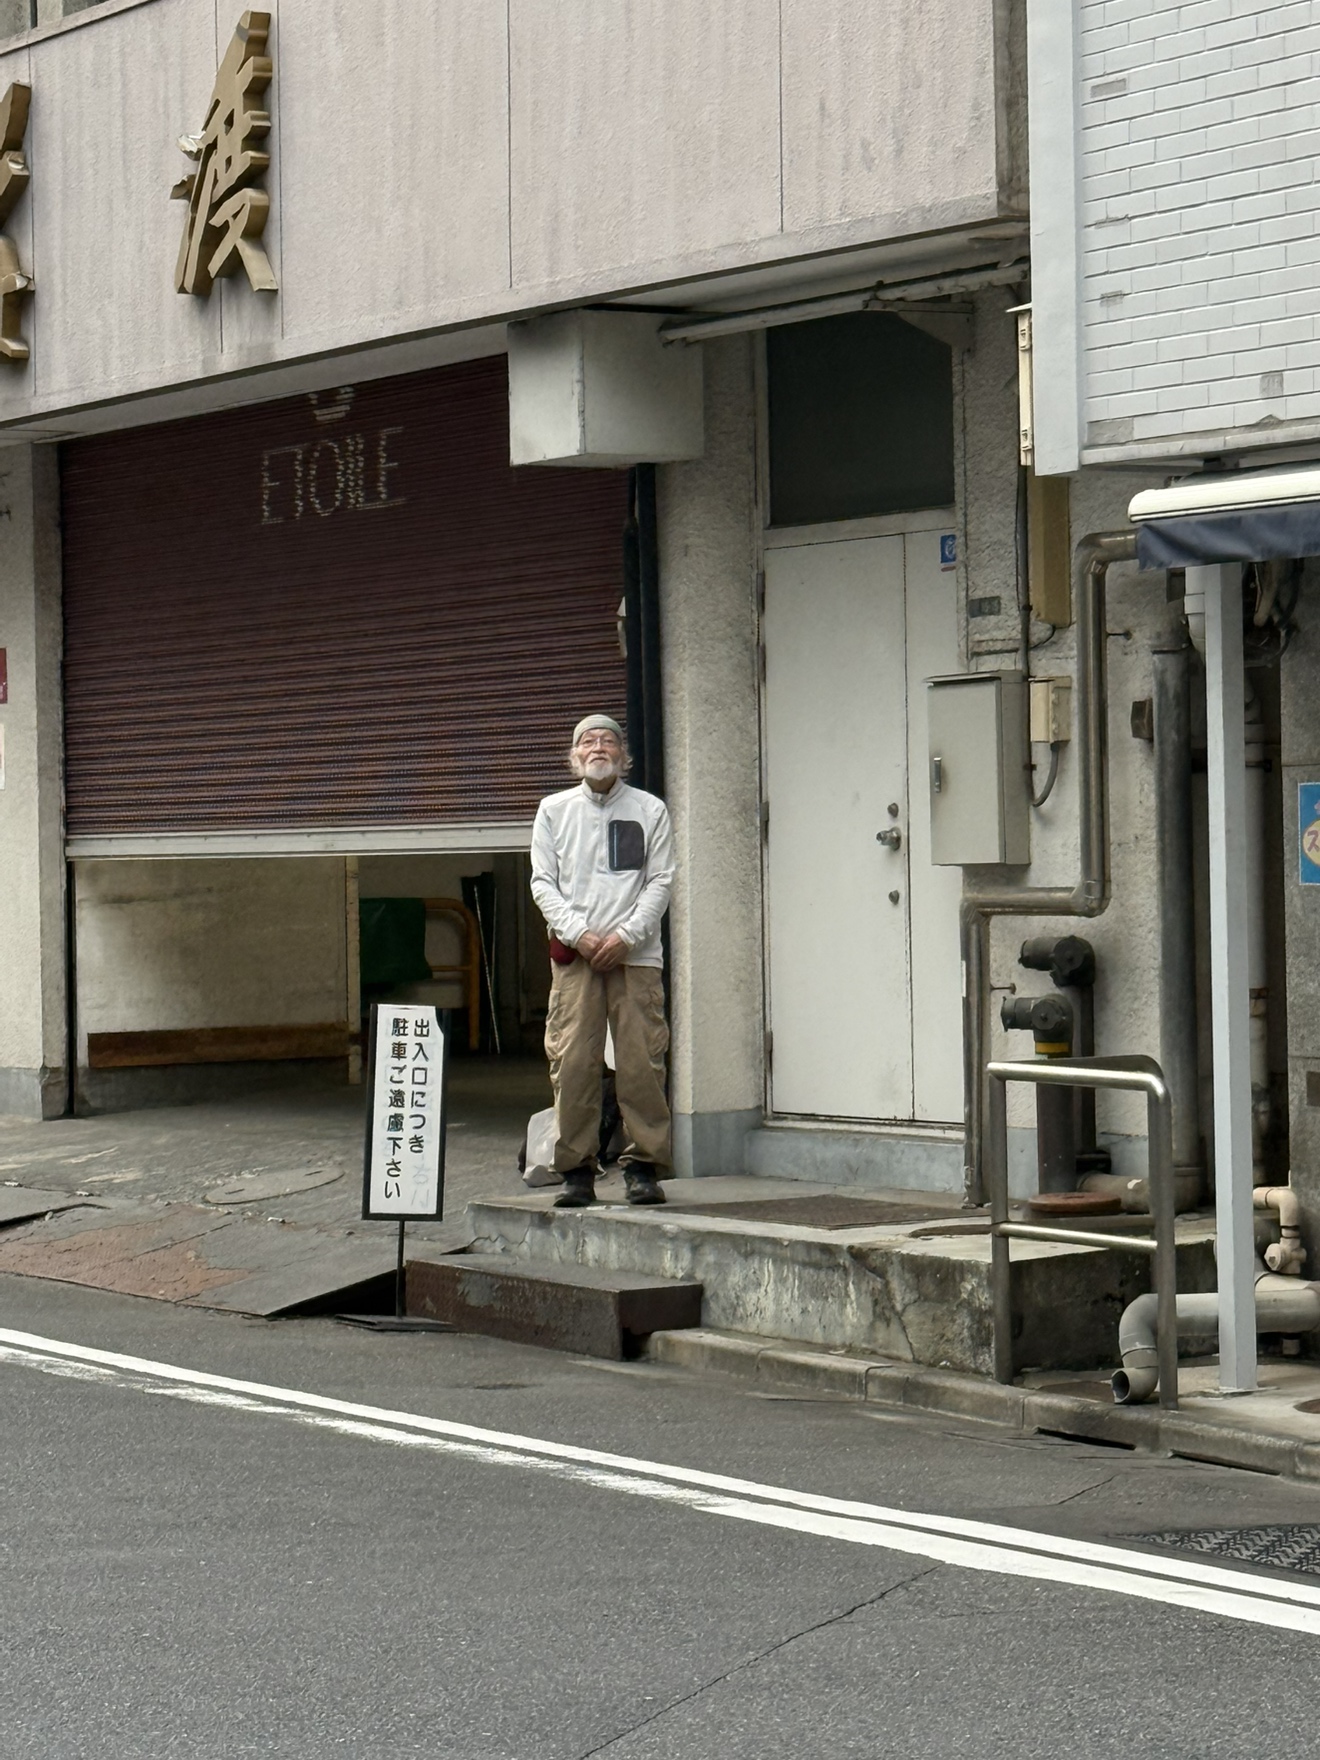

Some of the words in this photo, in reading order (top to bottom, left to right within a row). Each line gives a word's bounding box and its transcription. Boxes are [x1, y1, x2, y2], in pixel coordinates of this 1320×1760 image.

[261, 426, 404, 525] ETOILE
[384, 1017, 409, 1199] 駐車ご遠慮下さい
[409, 1018, 430, 1154] 出入口につき
